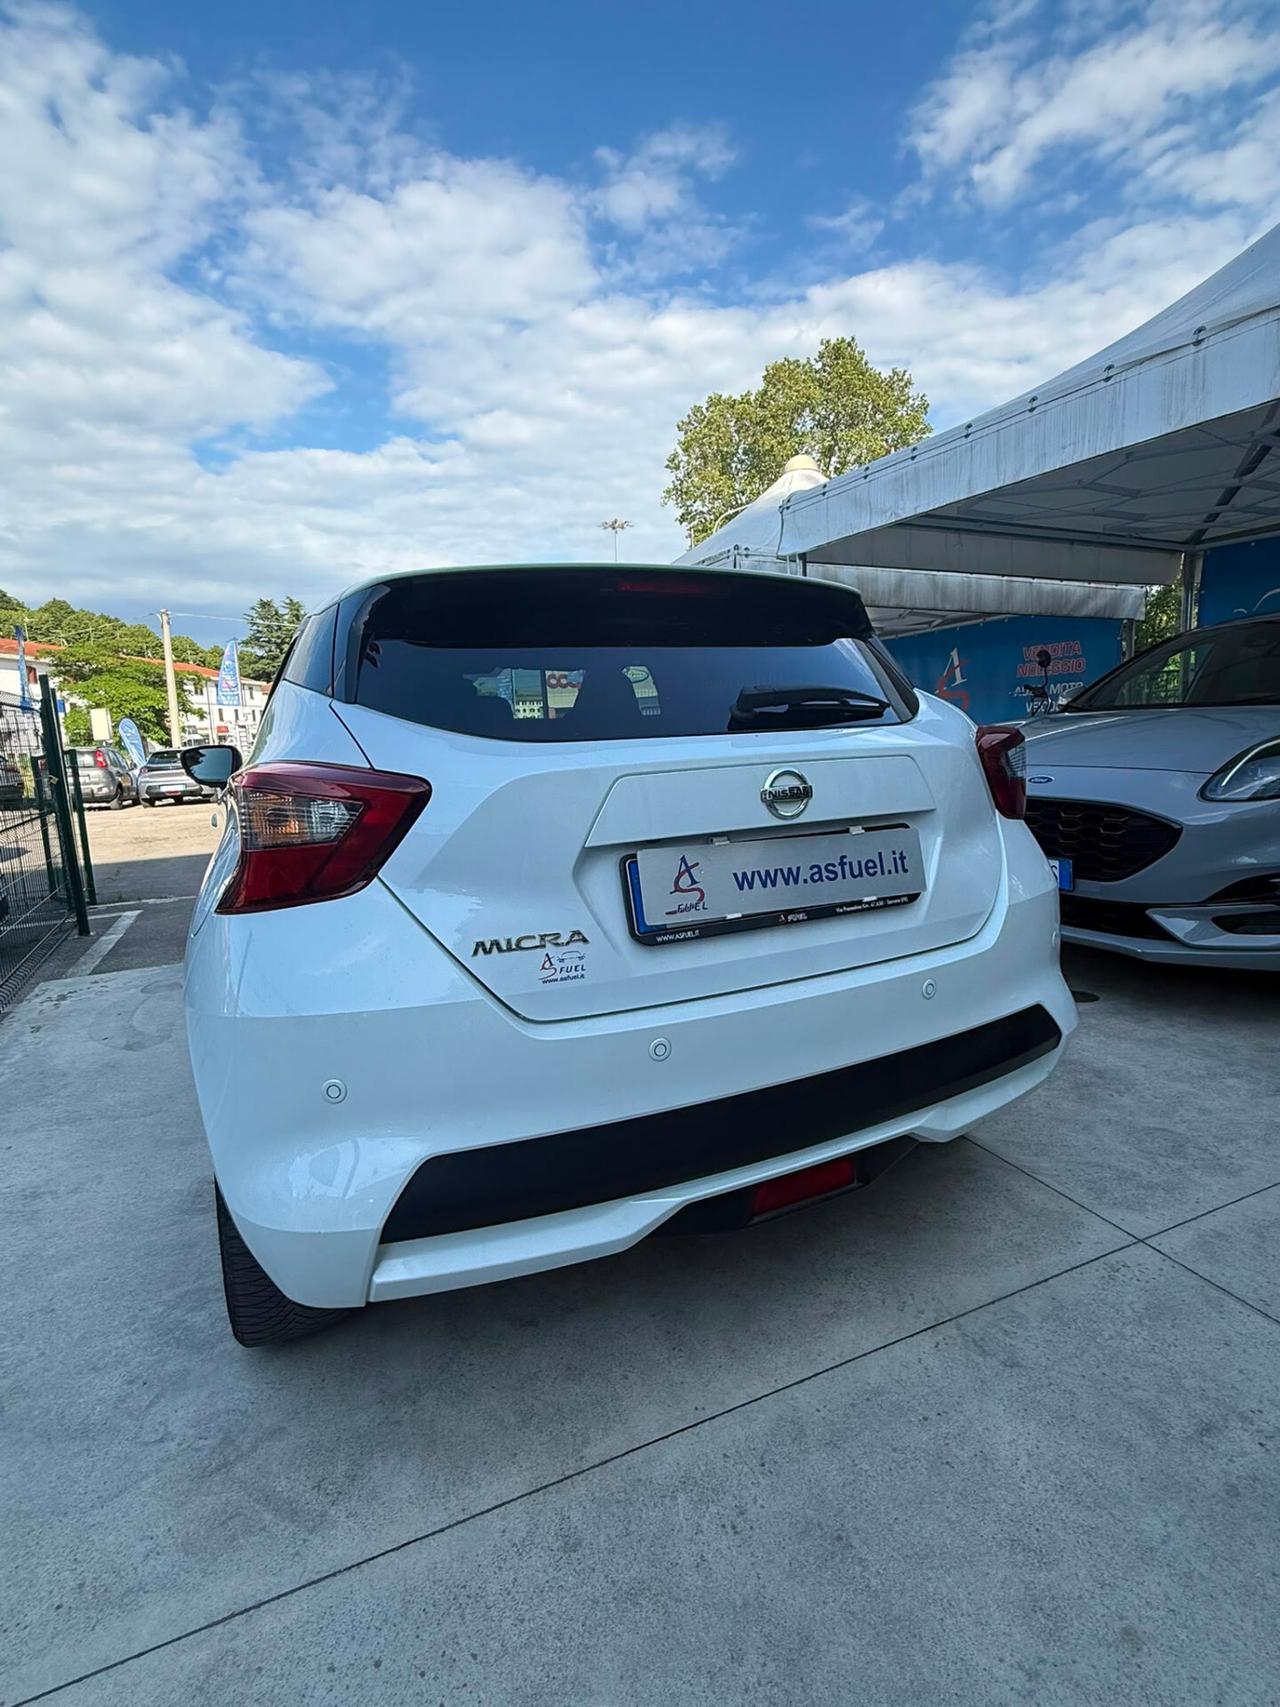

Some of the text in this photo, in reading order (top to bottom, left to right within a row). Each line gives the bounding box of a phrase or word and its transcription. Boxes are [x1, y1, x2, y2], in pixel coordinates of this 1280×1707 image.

[766, 785, 811, 800] NISSAN
[732, 850, 909, 891] www.asfuel.it
[677, 901, 708, 914] FUEL
[472, 930, 591, 957] MICRA
[559, 964, 586, 974] FUEL
[542, 974, 585, 984] www.asfuel.it
